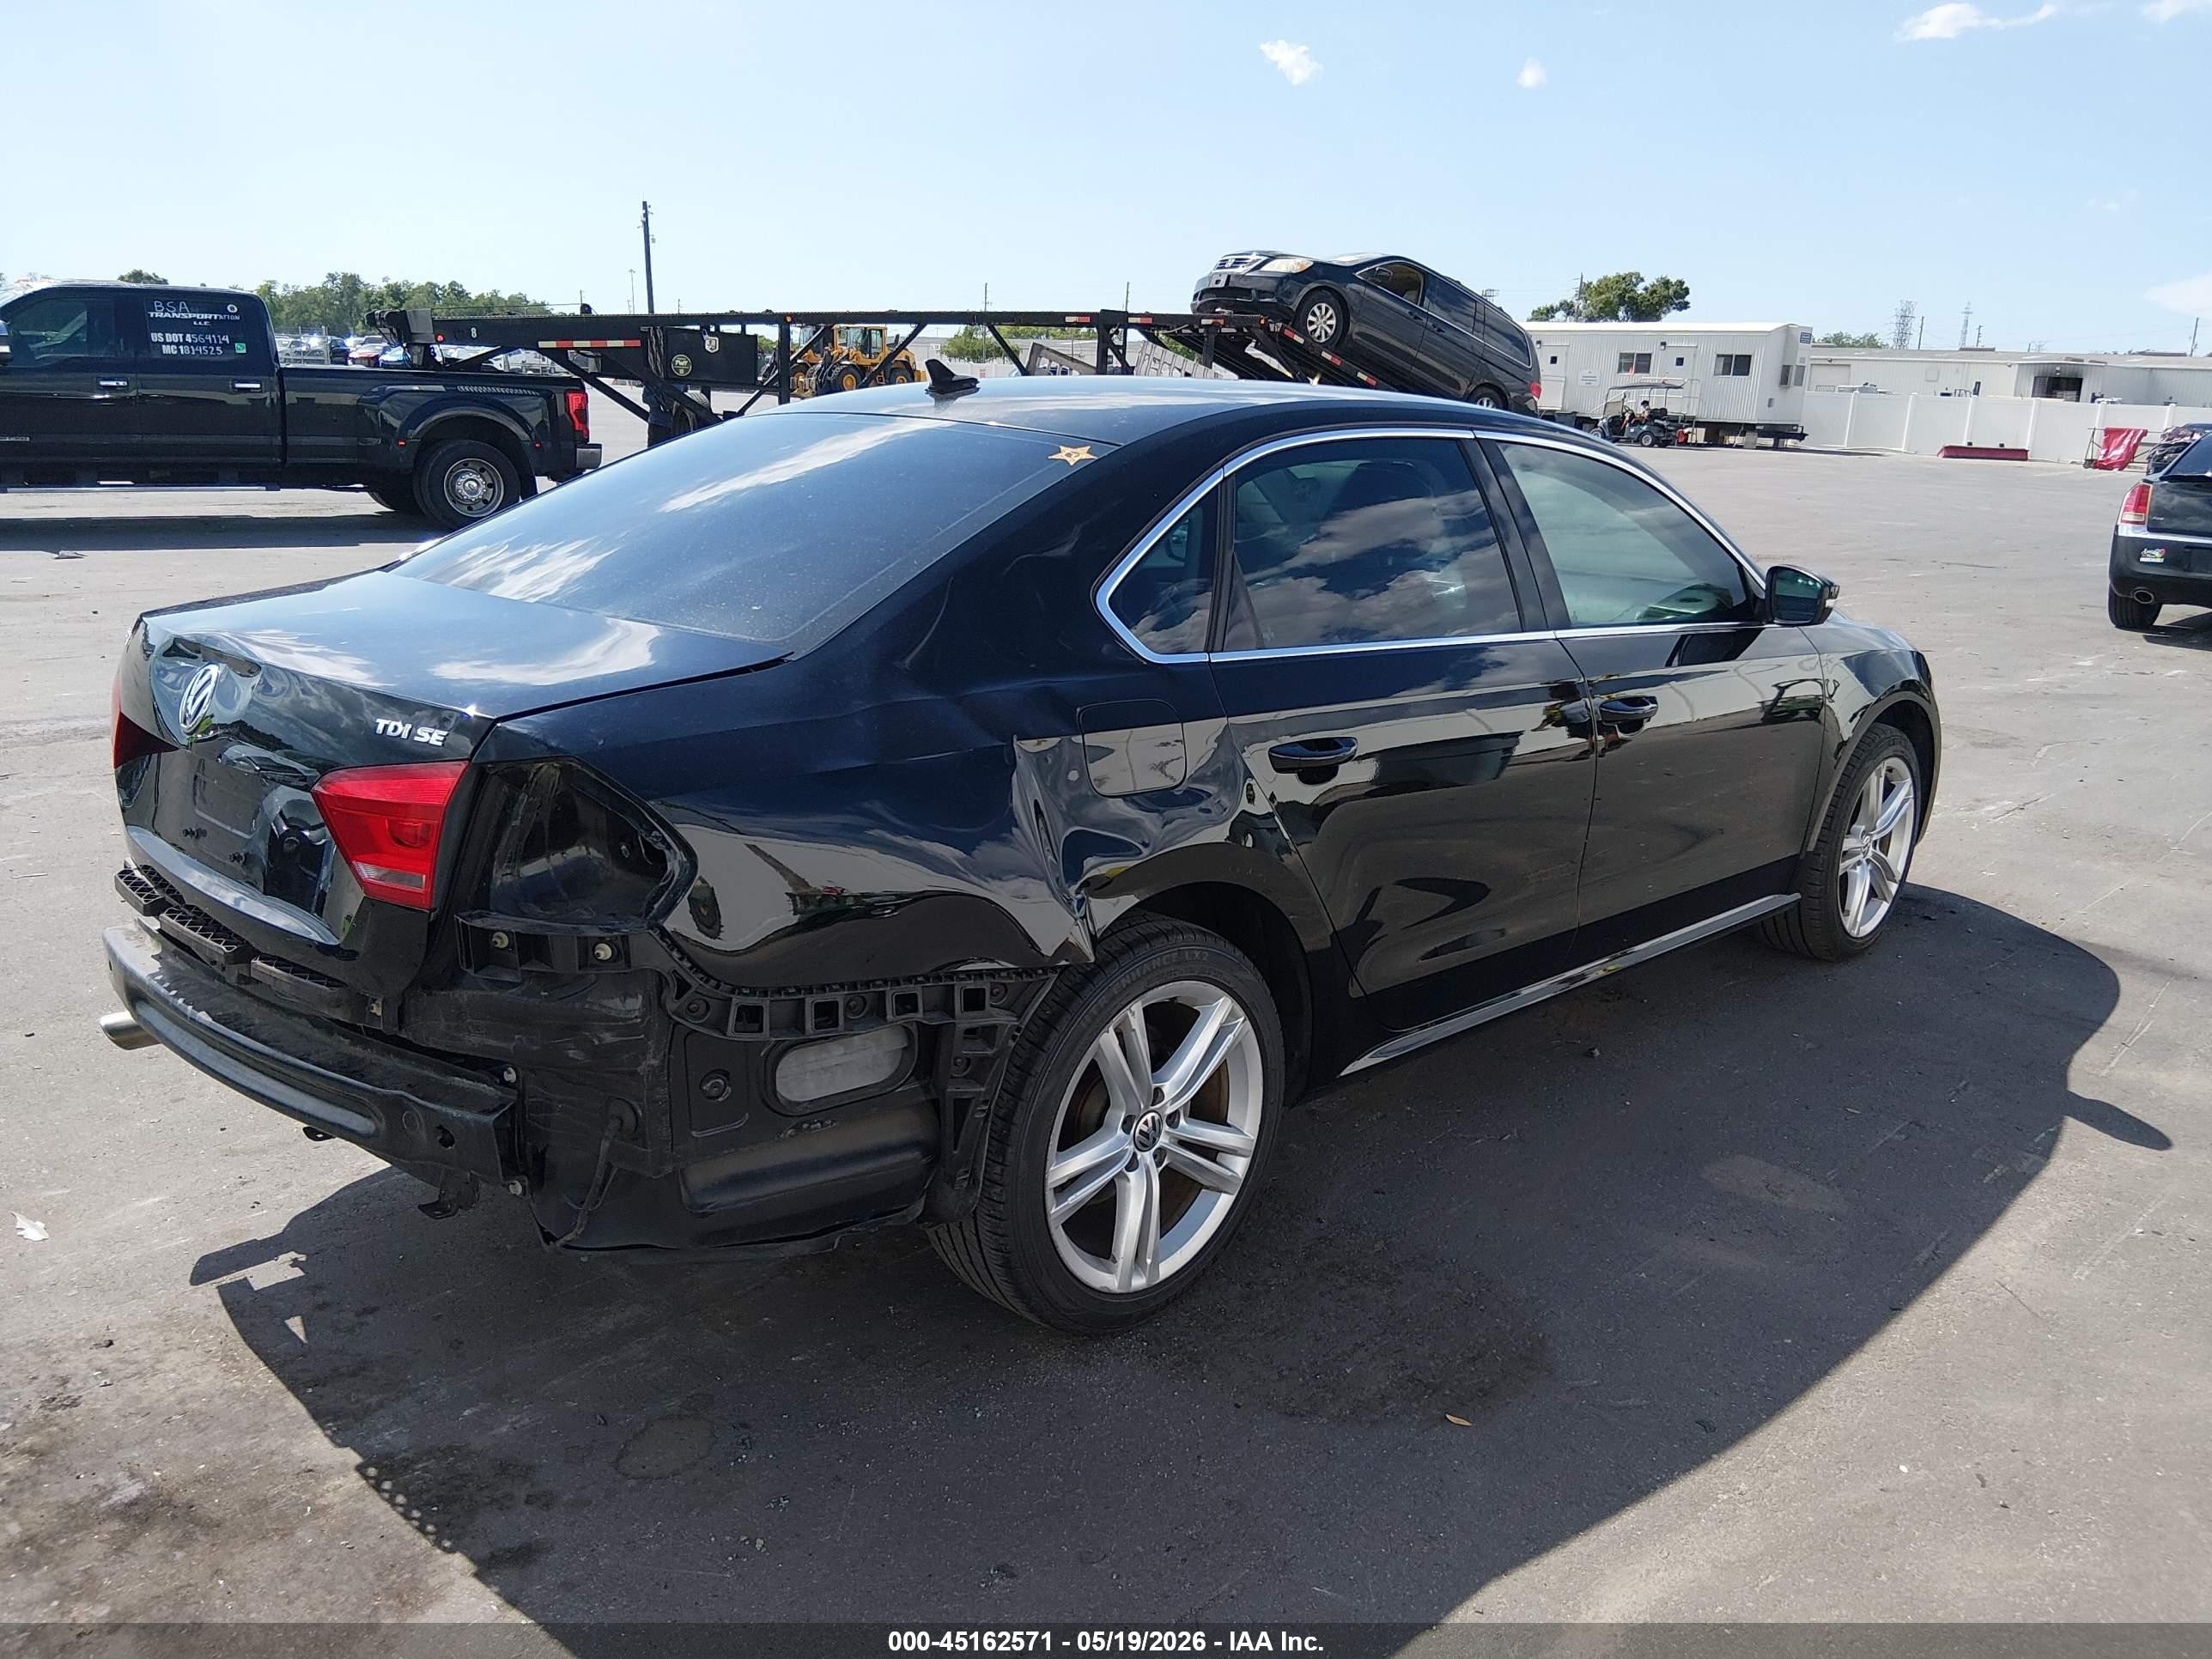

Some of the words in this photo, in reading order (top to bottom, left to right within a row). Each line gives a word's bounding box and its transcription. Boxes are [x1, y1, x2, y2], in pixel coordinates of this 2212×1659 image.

[155, 301, 190, 313] BSA
[148, 312, 240, 320] TRANSPORTATION
[151, 332, 163, 342] US
[166, 333, 183, 343] DOT
[185, 333, 229, 344] 4564114
[471, 327, 477, 338] 8
[162, 345, 177, 354] MC
[375, 718, 412, 739] TDI
[413, 726, 448, 747] SE
